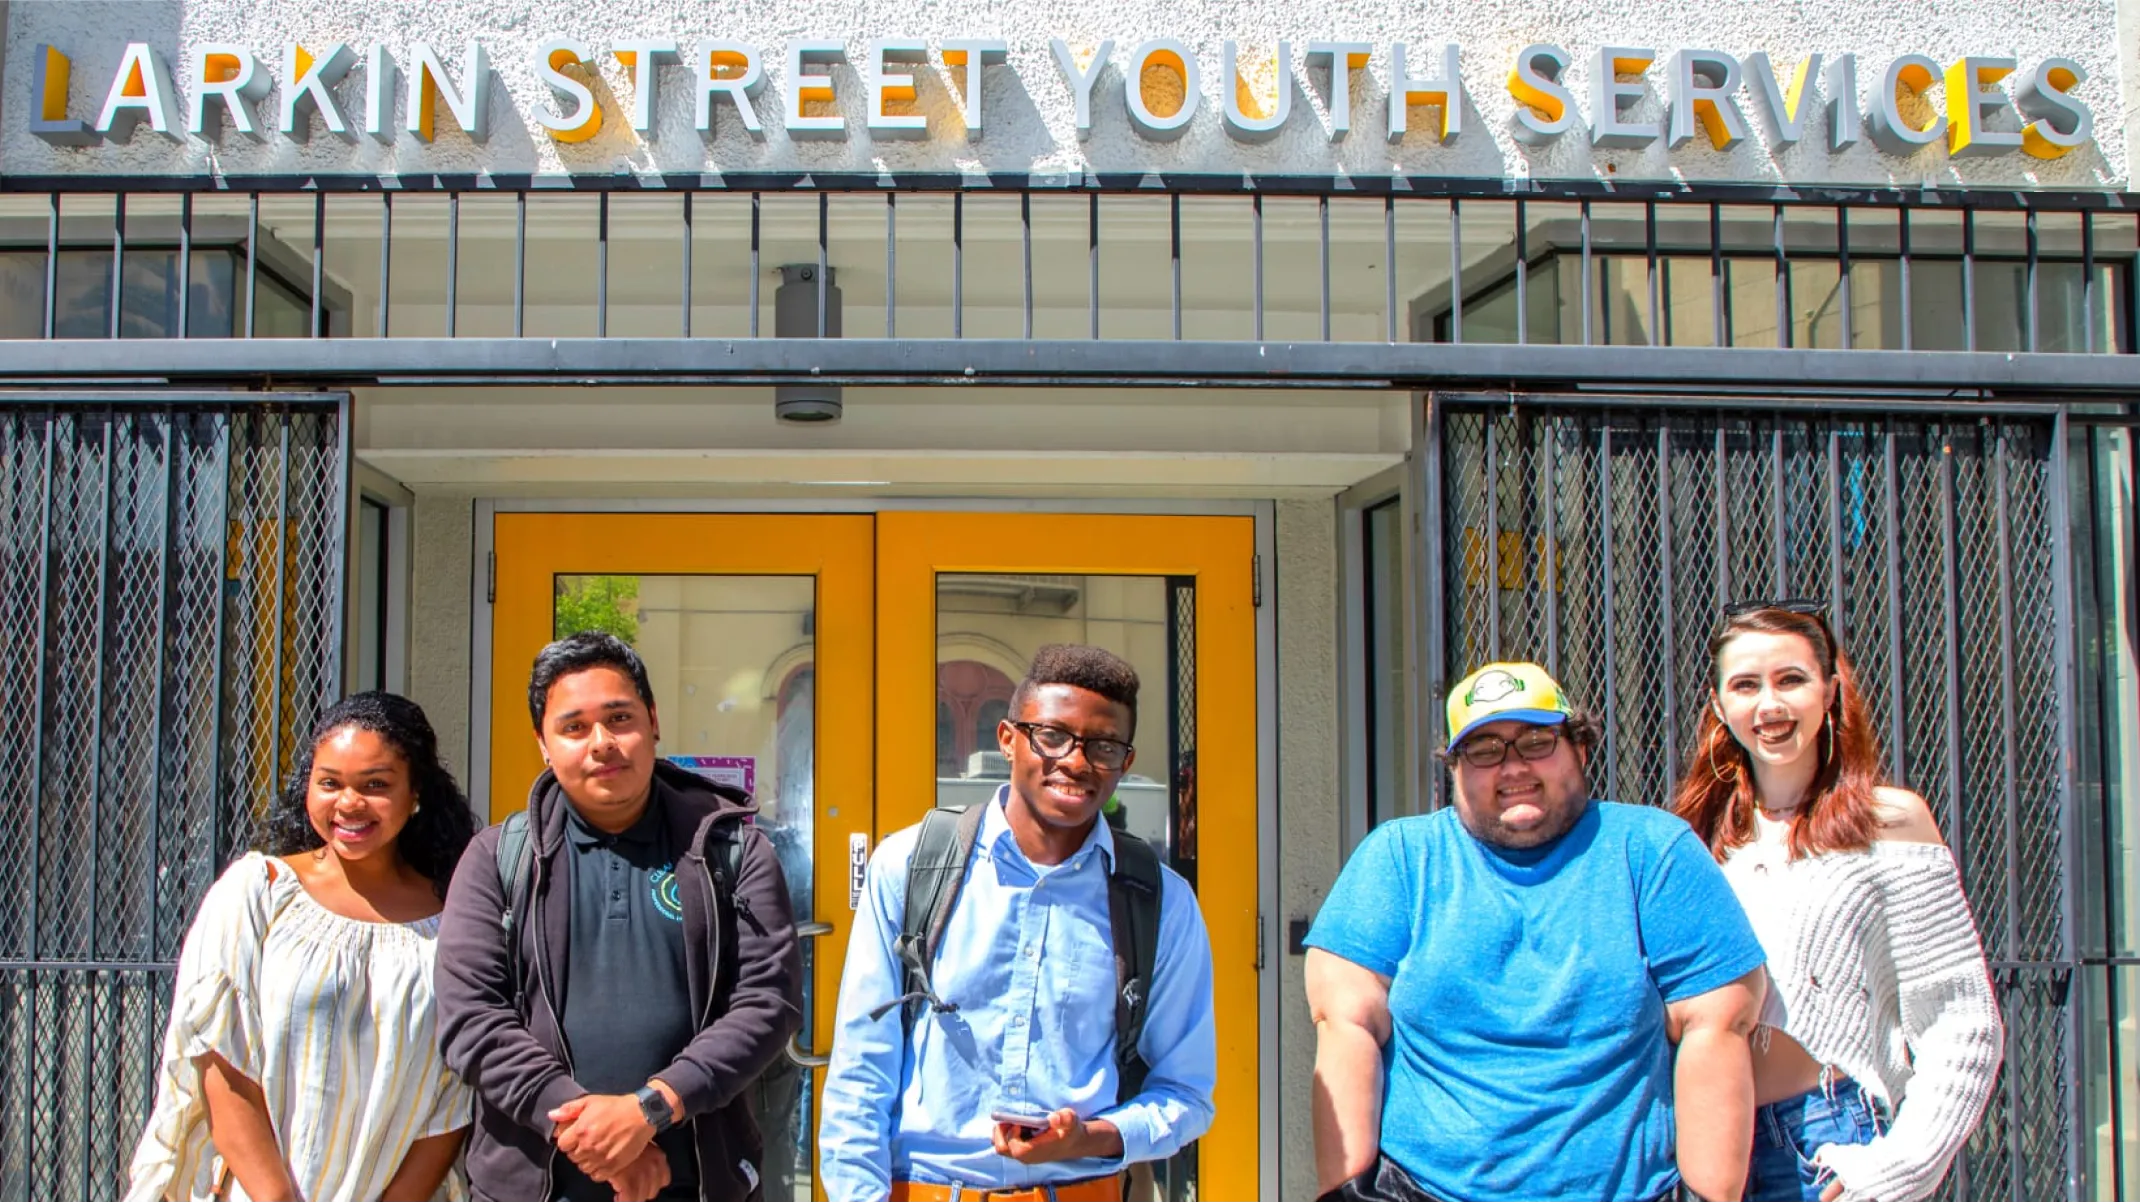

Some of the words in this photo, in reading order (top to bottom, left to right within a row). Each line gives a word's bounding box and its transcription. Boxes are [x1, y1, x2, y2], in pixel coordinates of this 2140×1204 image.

[29, 41, 490, 146] LARKIN
[531, 38, 1007, 143] STREET
[1049, 38, 1461, 145] YOUTH
[1507, 44, 2094, 159] SERVICES
[852, 838, 865, 891] PULL
